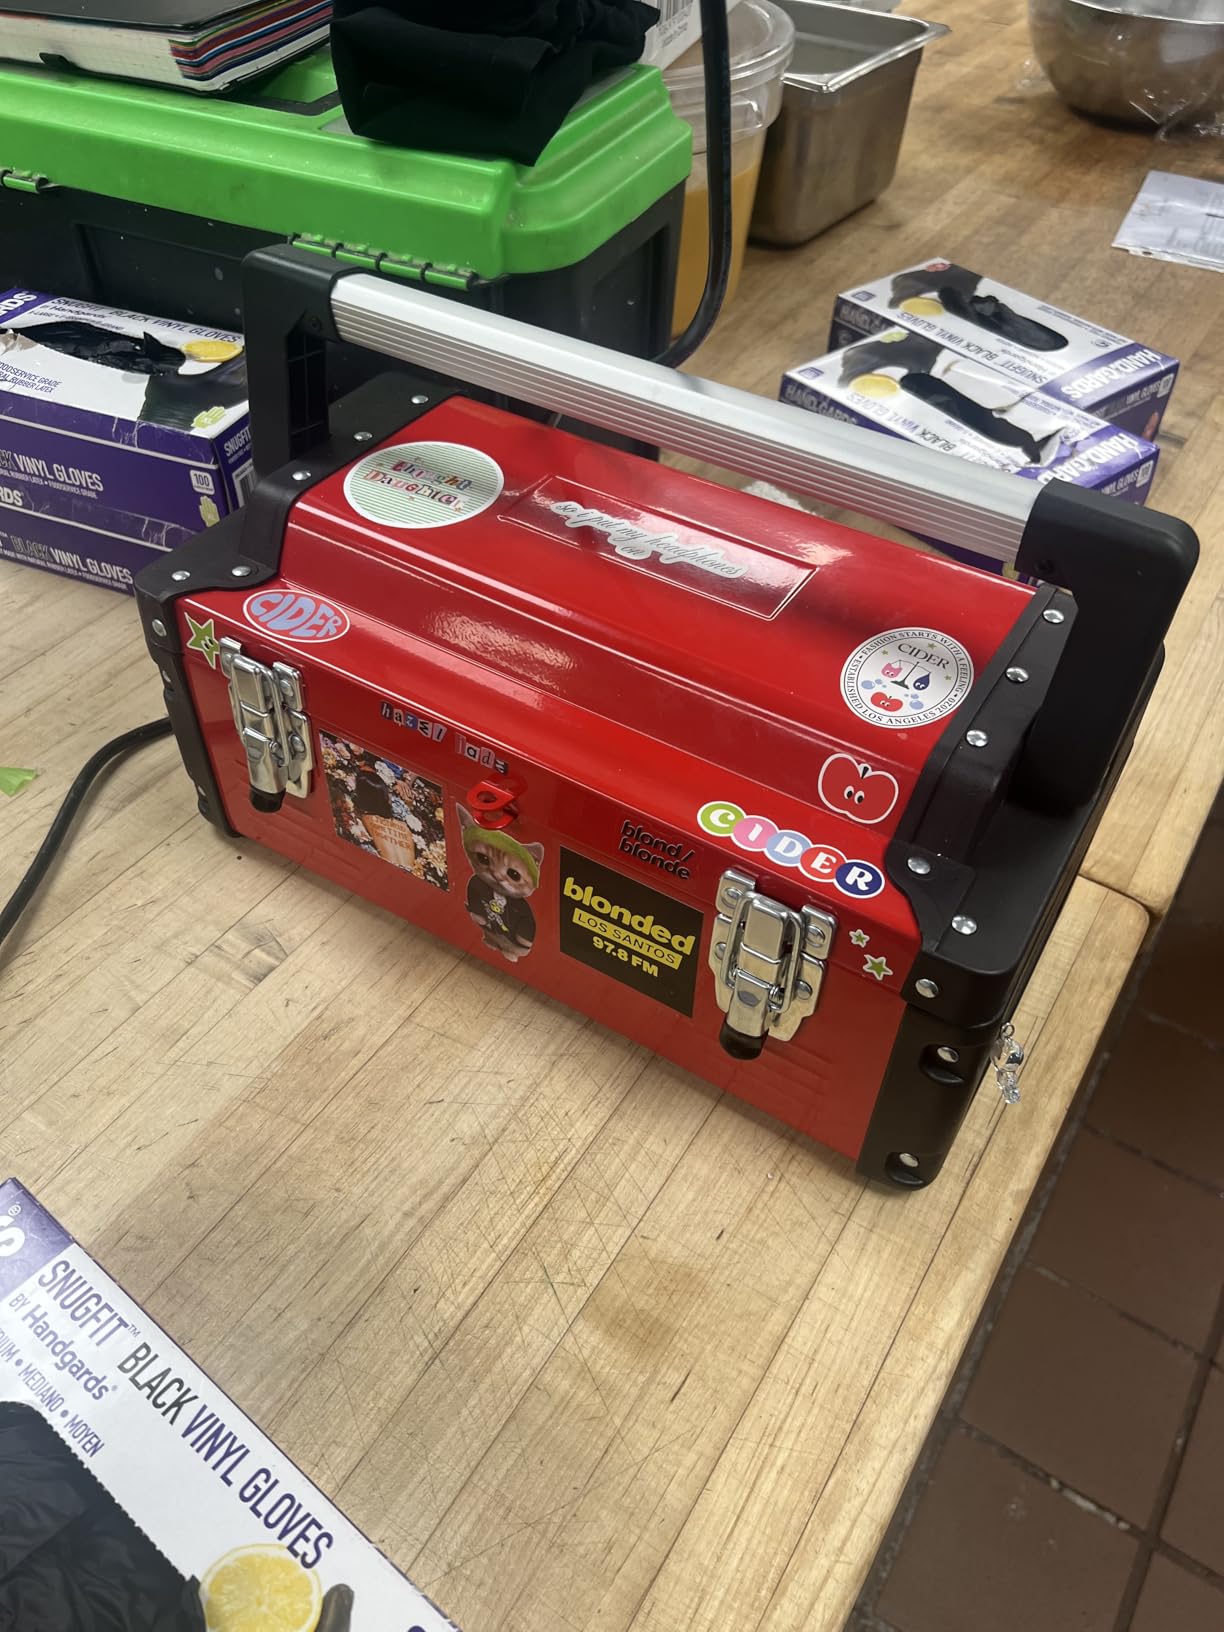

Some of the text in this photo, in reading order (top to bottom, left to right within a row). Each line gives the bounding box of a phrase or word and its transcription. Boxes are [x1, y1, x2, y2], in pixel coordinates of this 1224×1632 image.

[109, 310, 149, 322] BLACK
[152, 319, 186, 332] VINYL
[188, 328, 240, 343] GLOVES
[13, 453, 55, 480] VINYL
[53, 463, 104, 492] GLOVES
[193, 472, 210, 487] 100
[49, 547, 88, 572] VINYL
[86, 557, 134, 585] GLOVES
[249, 593, 343, 638] CIDER
[863, 634, 897, 656] FASHION
[899, 631, 938, 640] STARTS
[940, 637, 962, 656] WITH
[954, 662, 968, 697] FEELING
[897, 642, 950, 670] CIDER
[846, 658, 956, 725] ESTABLISHED LOS ANGELES 2020
[618, 836, 692, 880] blonde
[705, 806, 877, 893] CIDER
[563, 877, 696, 956] blonded
[578, 911, 677, 966] LOS SANTOS
[592, 935, 660, 978] 97.8 FM
[9, 1292, 31, 1316] BY
[18, 1362, 66, 1414] MEDIANO
[62, 1413, 106, 1458] MOYEN
[117, 1342, 200, 1426] BLACK
[181, 1404, 251, 1487] VINYL
[238, 1467, 335, 1570] GLOVES
